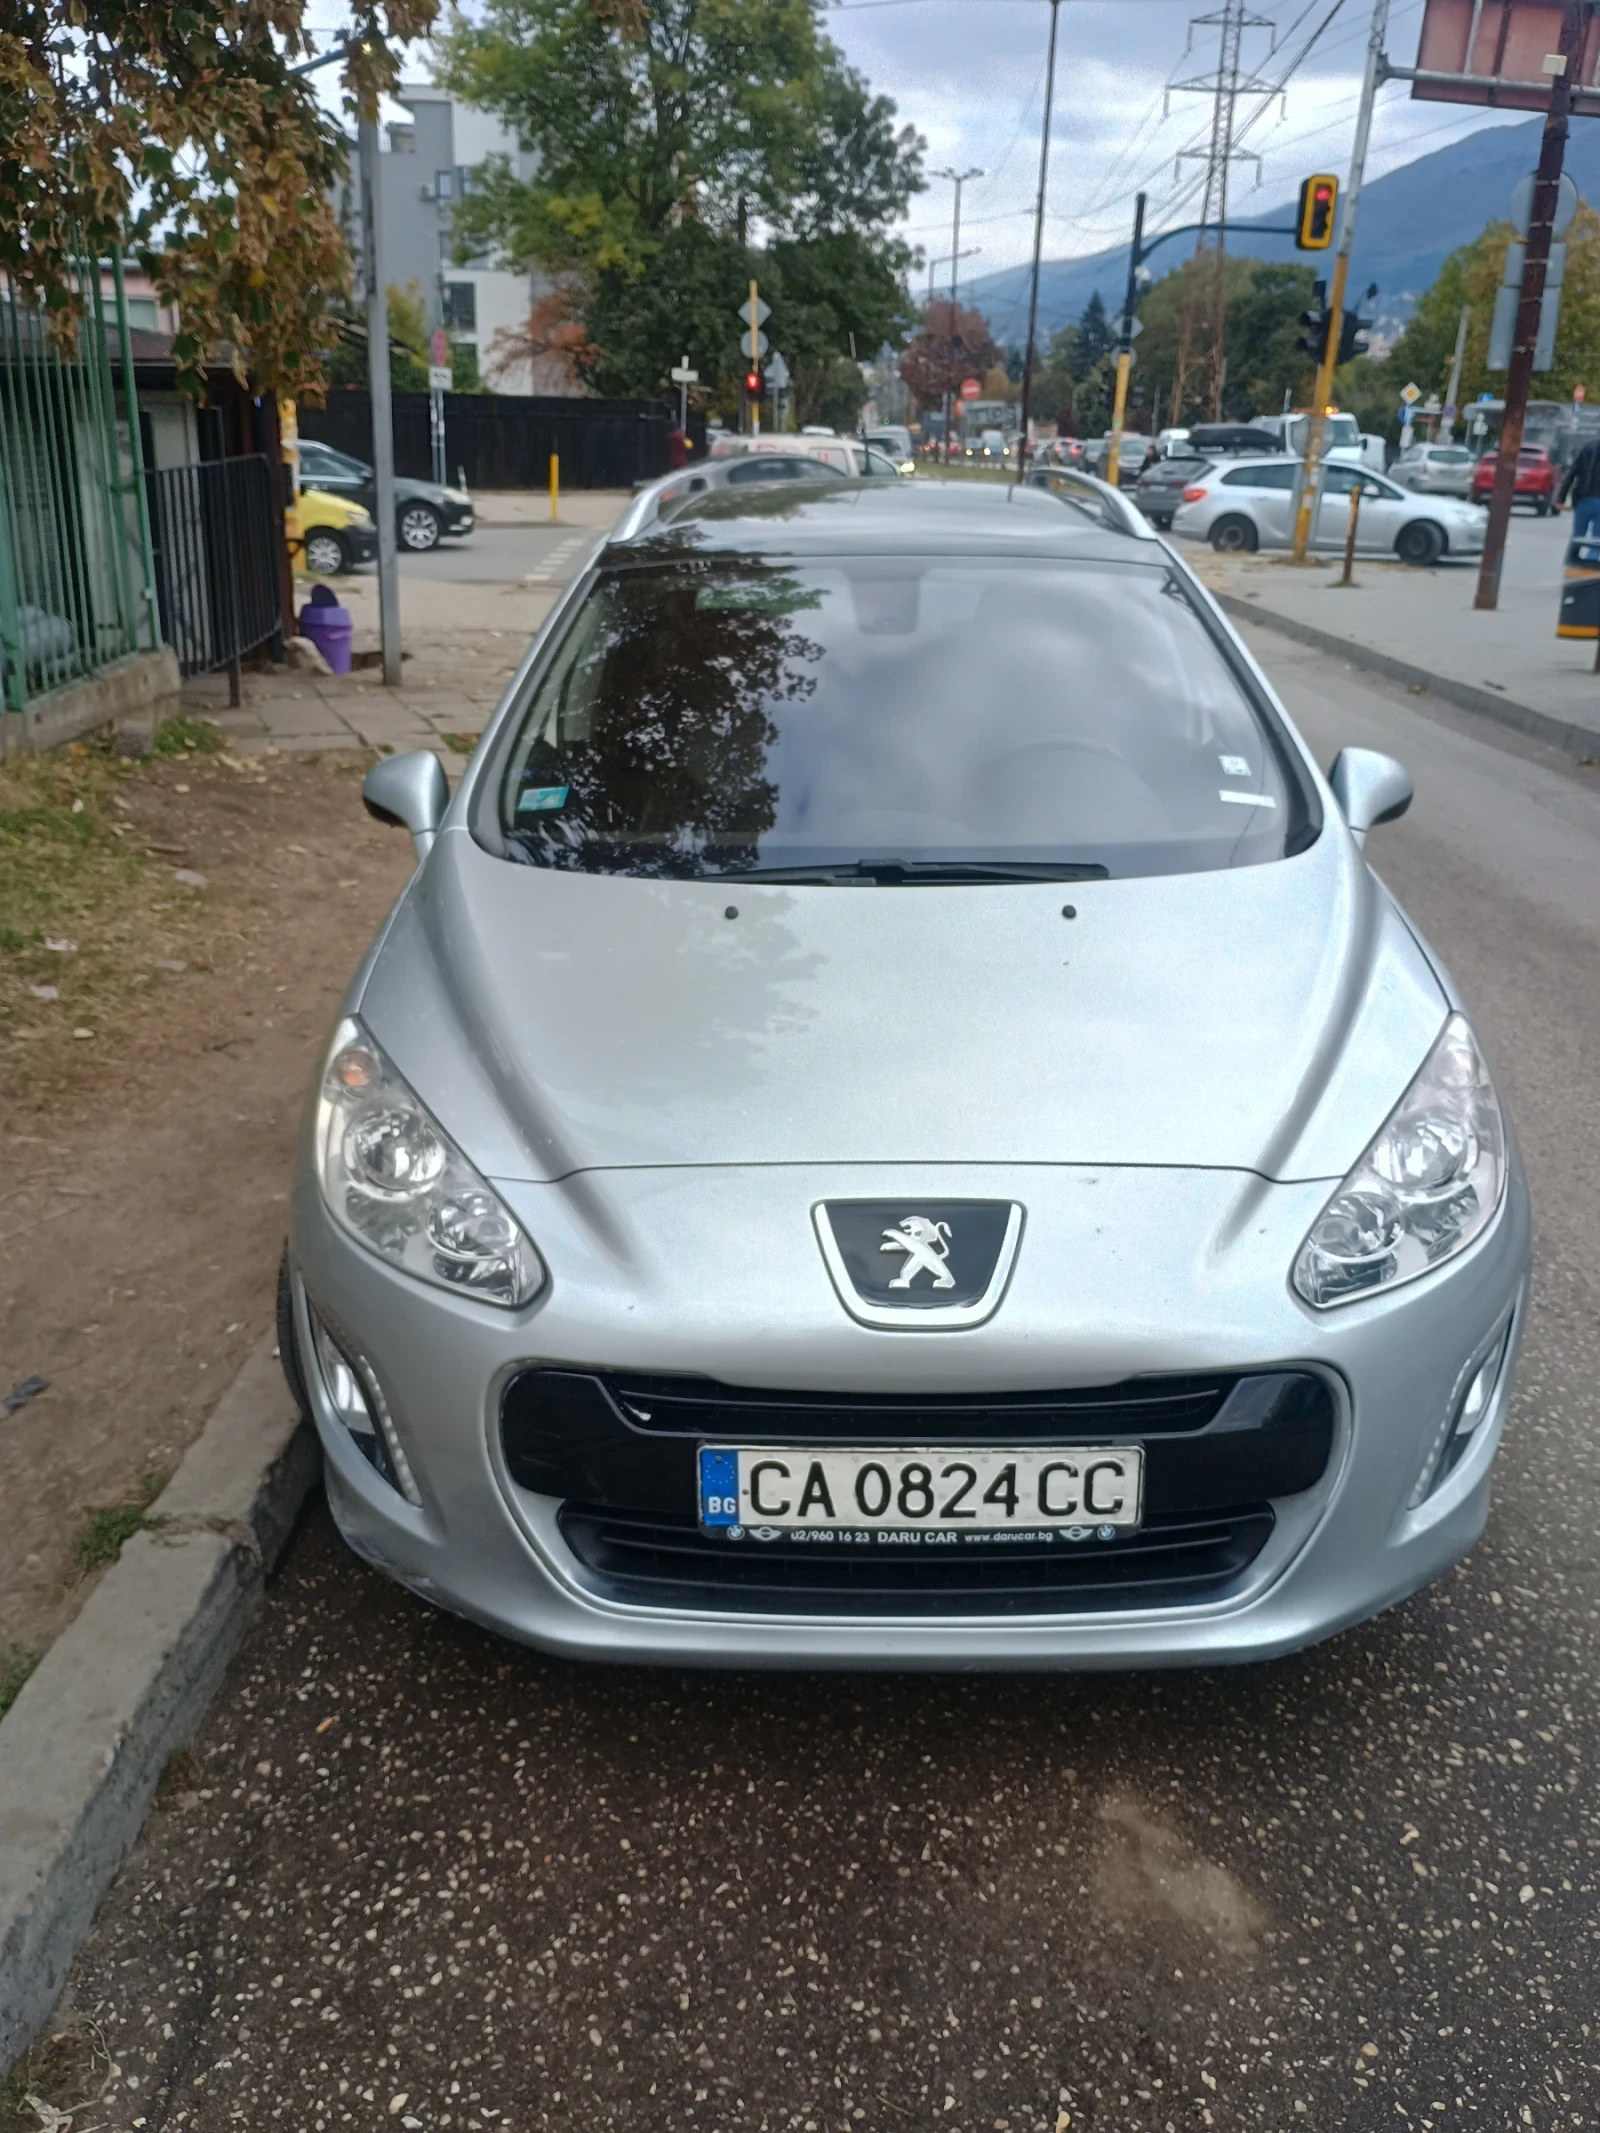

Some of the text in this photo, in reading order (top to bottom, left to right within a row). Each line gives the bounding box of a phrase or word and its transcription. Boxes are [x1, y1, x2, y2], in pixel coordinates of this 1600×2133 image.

[749, 1459, 1126, 1519] CA 0824 CC
[708, 1496, 736, 1514] BG
[790, 1530, 1054, 1544] 02/960 16 23 DARU CAR www.darucar.bg
